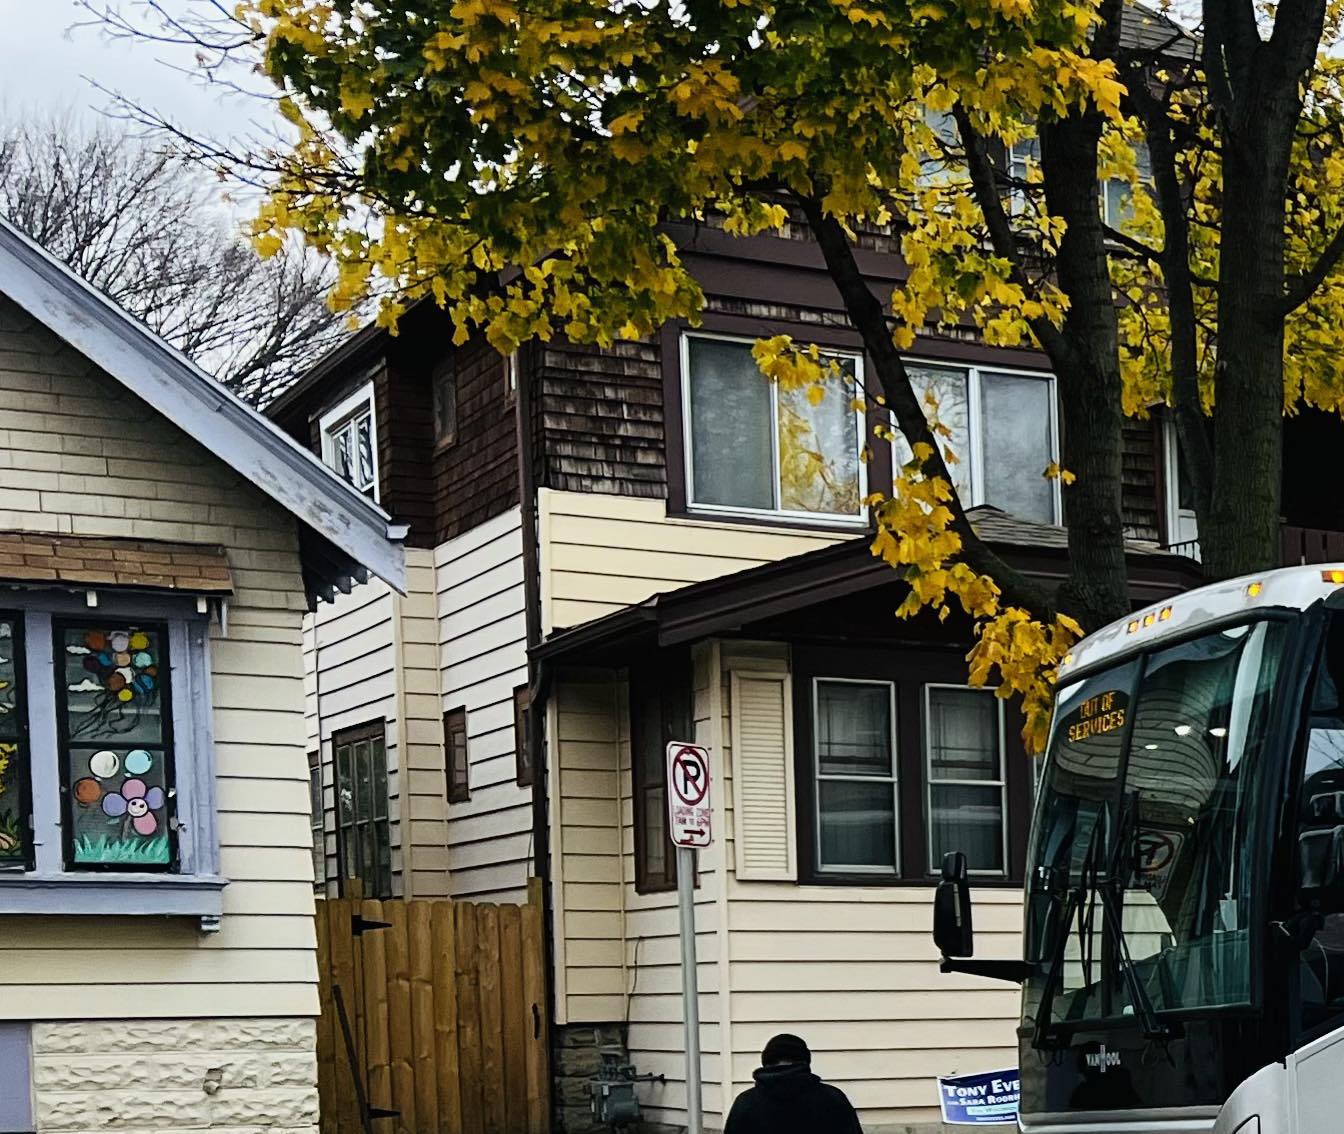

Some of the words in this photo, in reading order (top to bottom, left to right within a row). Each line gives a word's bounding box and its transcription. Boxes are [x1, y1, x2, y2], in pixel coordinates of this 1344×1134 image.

[1080, 697, 1098, 718] OUT
[1068, 708, 1125, 742] SERVICES
[990, 1079, 1020, 1094] EVE
